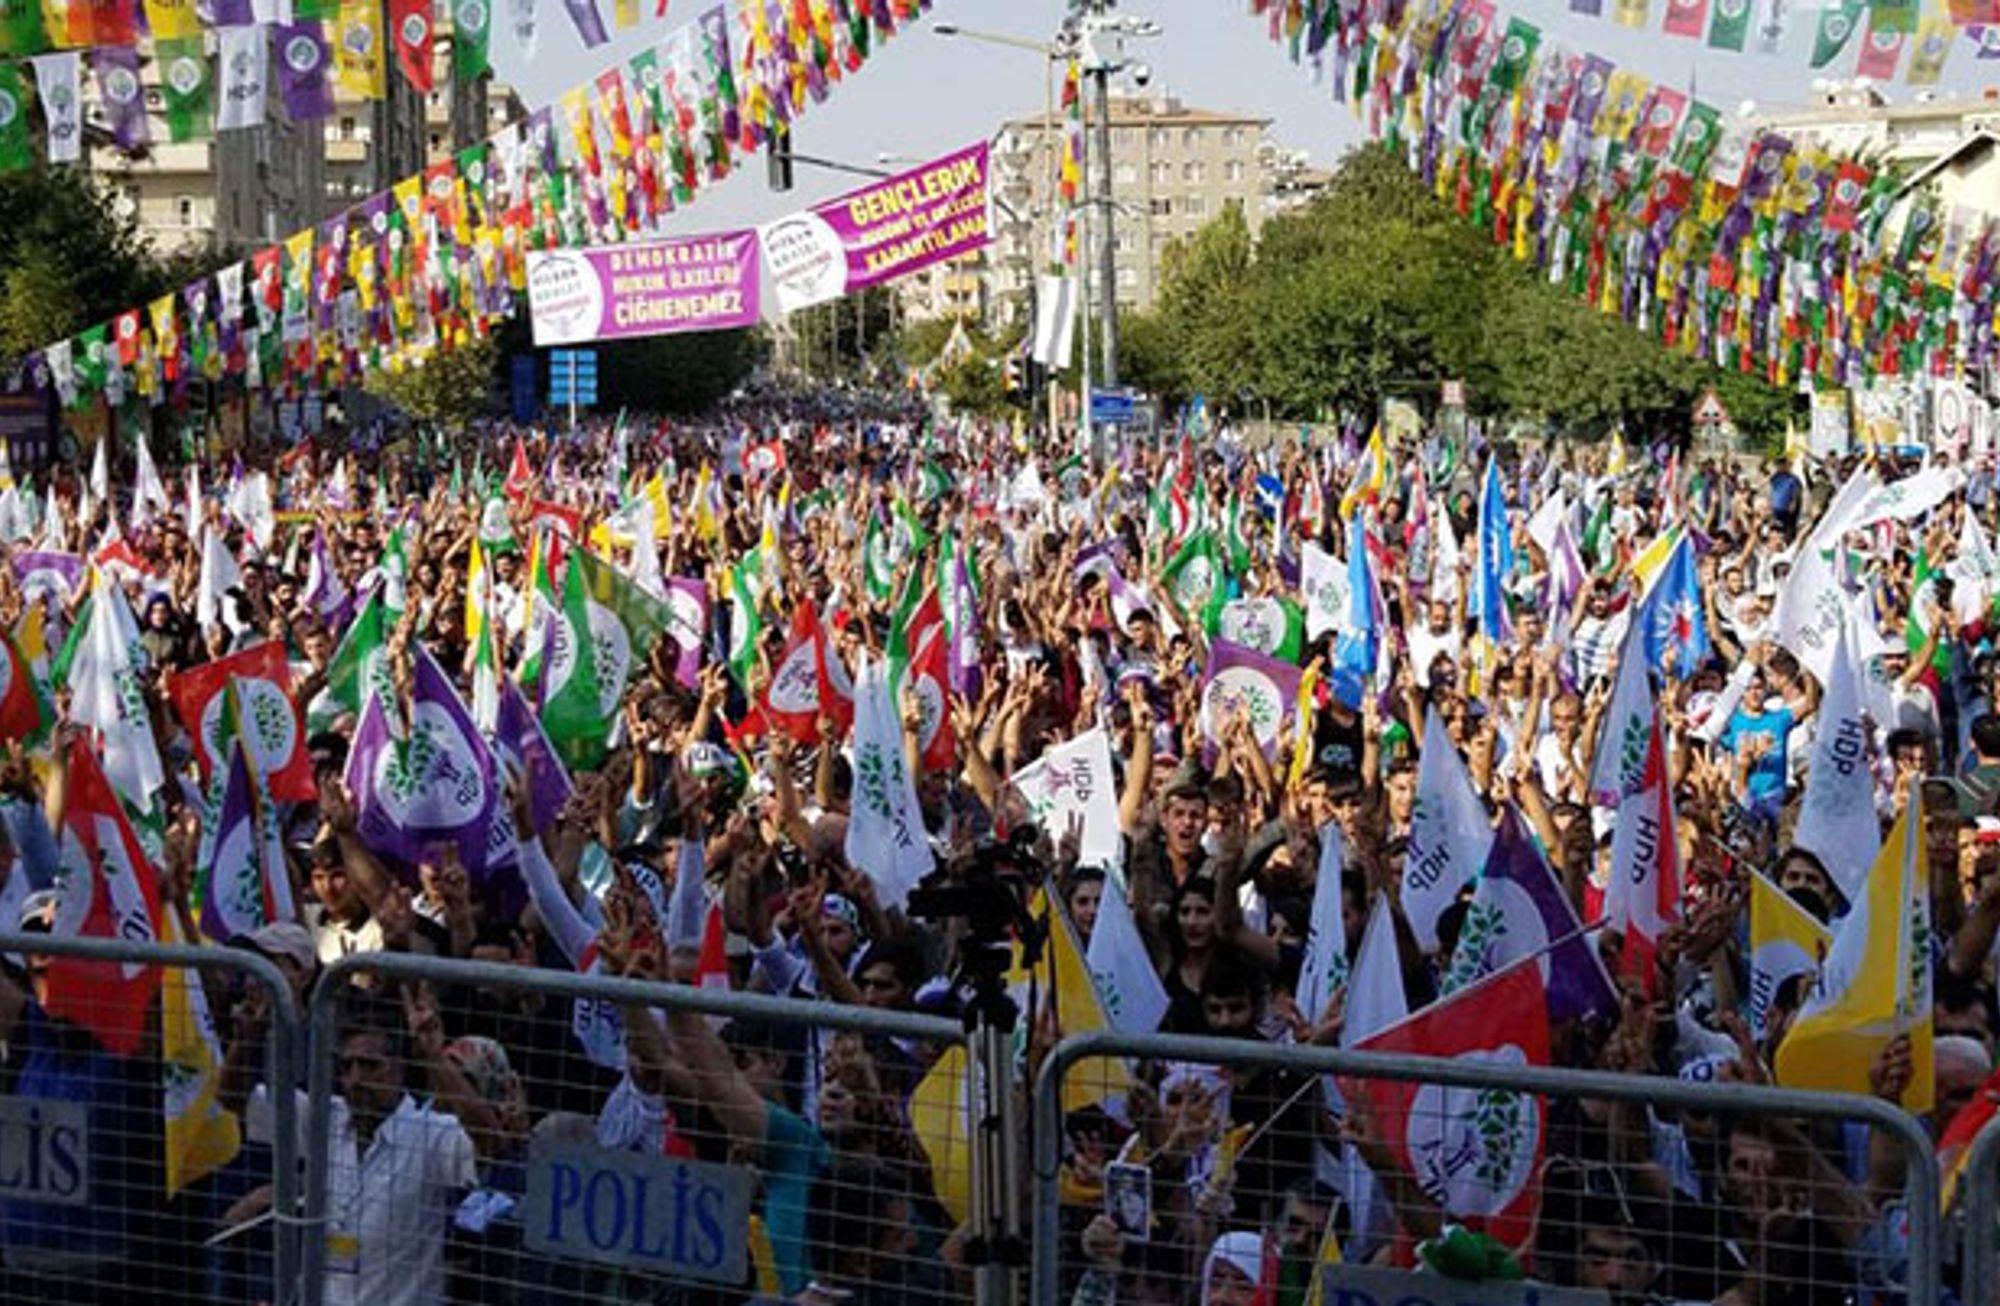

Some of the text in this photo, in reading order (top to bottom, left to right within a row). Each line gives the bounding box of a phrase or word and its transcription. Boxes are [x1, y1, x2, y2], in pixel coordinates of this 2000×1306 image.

[610, 240, 738, 271] DEMOKRATİK
[1830, 717, 1862, 776] HDP
[546, 1162, 725, 1269] POLİS
